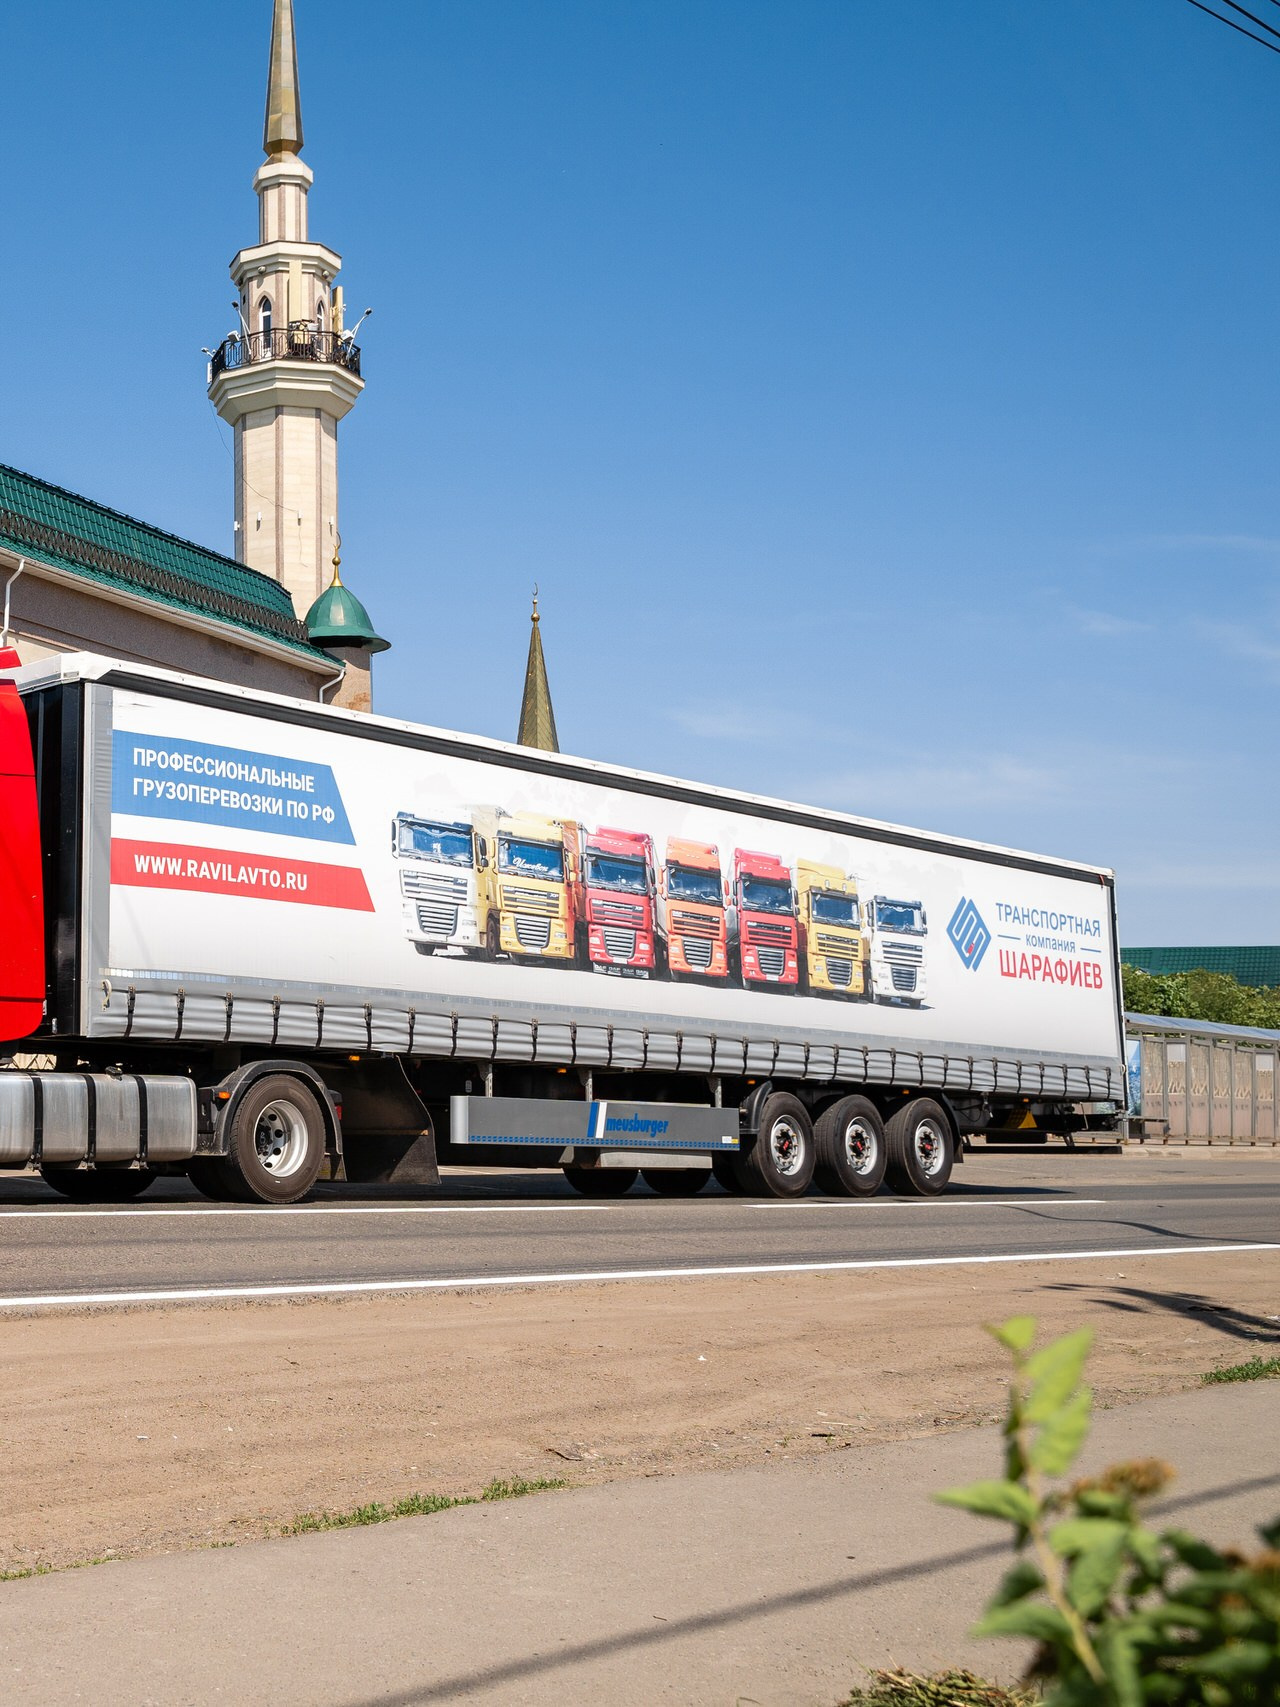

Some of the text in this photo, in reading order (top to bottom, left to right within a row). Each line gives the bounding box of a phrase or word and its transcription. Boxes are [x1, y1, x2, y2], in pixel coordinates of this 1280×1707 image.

[133, 747, 315, 793] ПРОФЕССИОНАЛЬНЫЕ
[133, 777, 335, 824] ГРУЗОПЕРЕВОЗКИ ПО РФ
[134, 854, 308, 891] WWW.RAVILAVTO.RU
[995, 902, 1101, 937] ТРАНСПОРТНАЯ
[1025, 934, 1076, 953] компания
[999, 949, 1103, 989] ШАРАФИЕВ
[605, 1113, 670, 1138] meusburger
